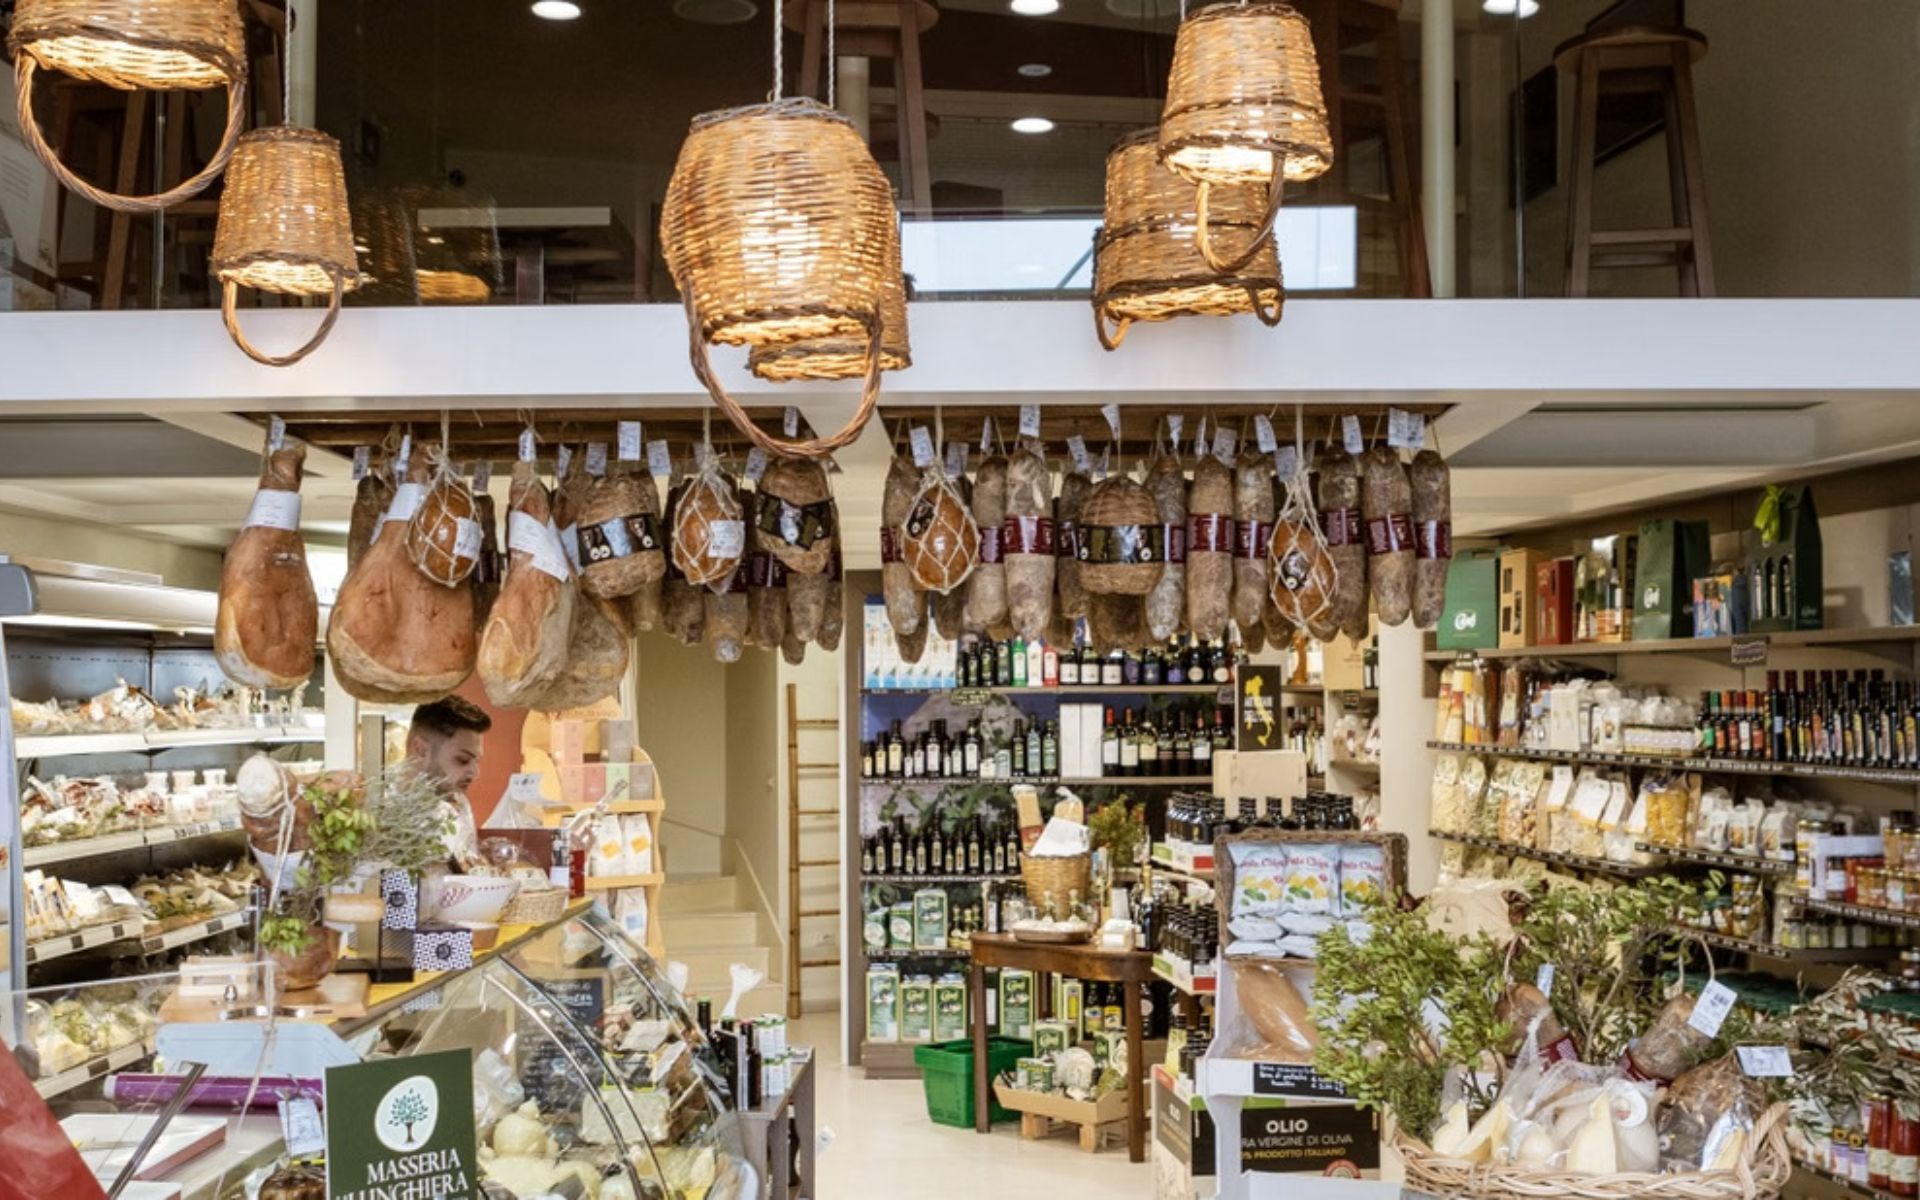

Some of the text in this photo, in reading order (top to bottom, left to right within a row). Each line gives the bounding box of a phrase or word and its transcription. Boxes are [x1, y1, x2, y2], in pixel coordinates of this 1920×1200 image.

[1265, 1118, 1309, 1134] OLIO
[1258, 1136, 1304, 1148] VERGINE
[1306, 1134, 1320, 1146] DI
[1321, 1134, 1354, 1146] OLIVA
[1254, 1149, 1303, 1159] PRODOTTO
[1304, 1147, 1347, 1157] ITALIANO
[368, 1149, 461, 1185] MASSERIA
